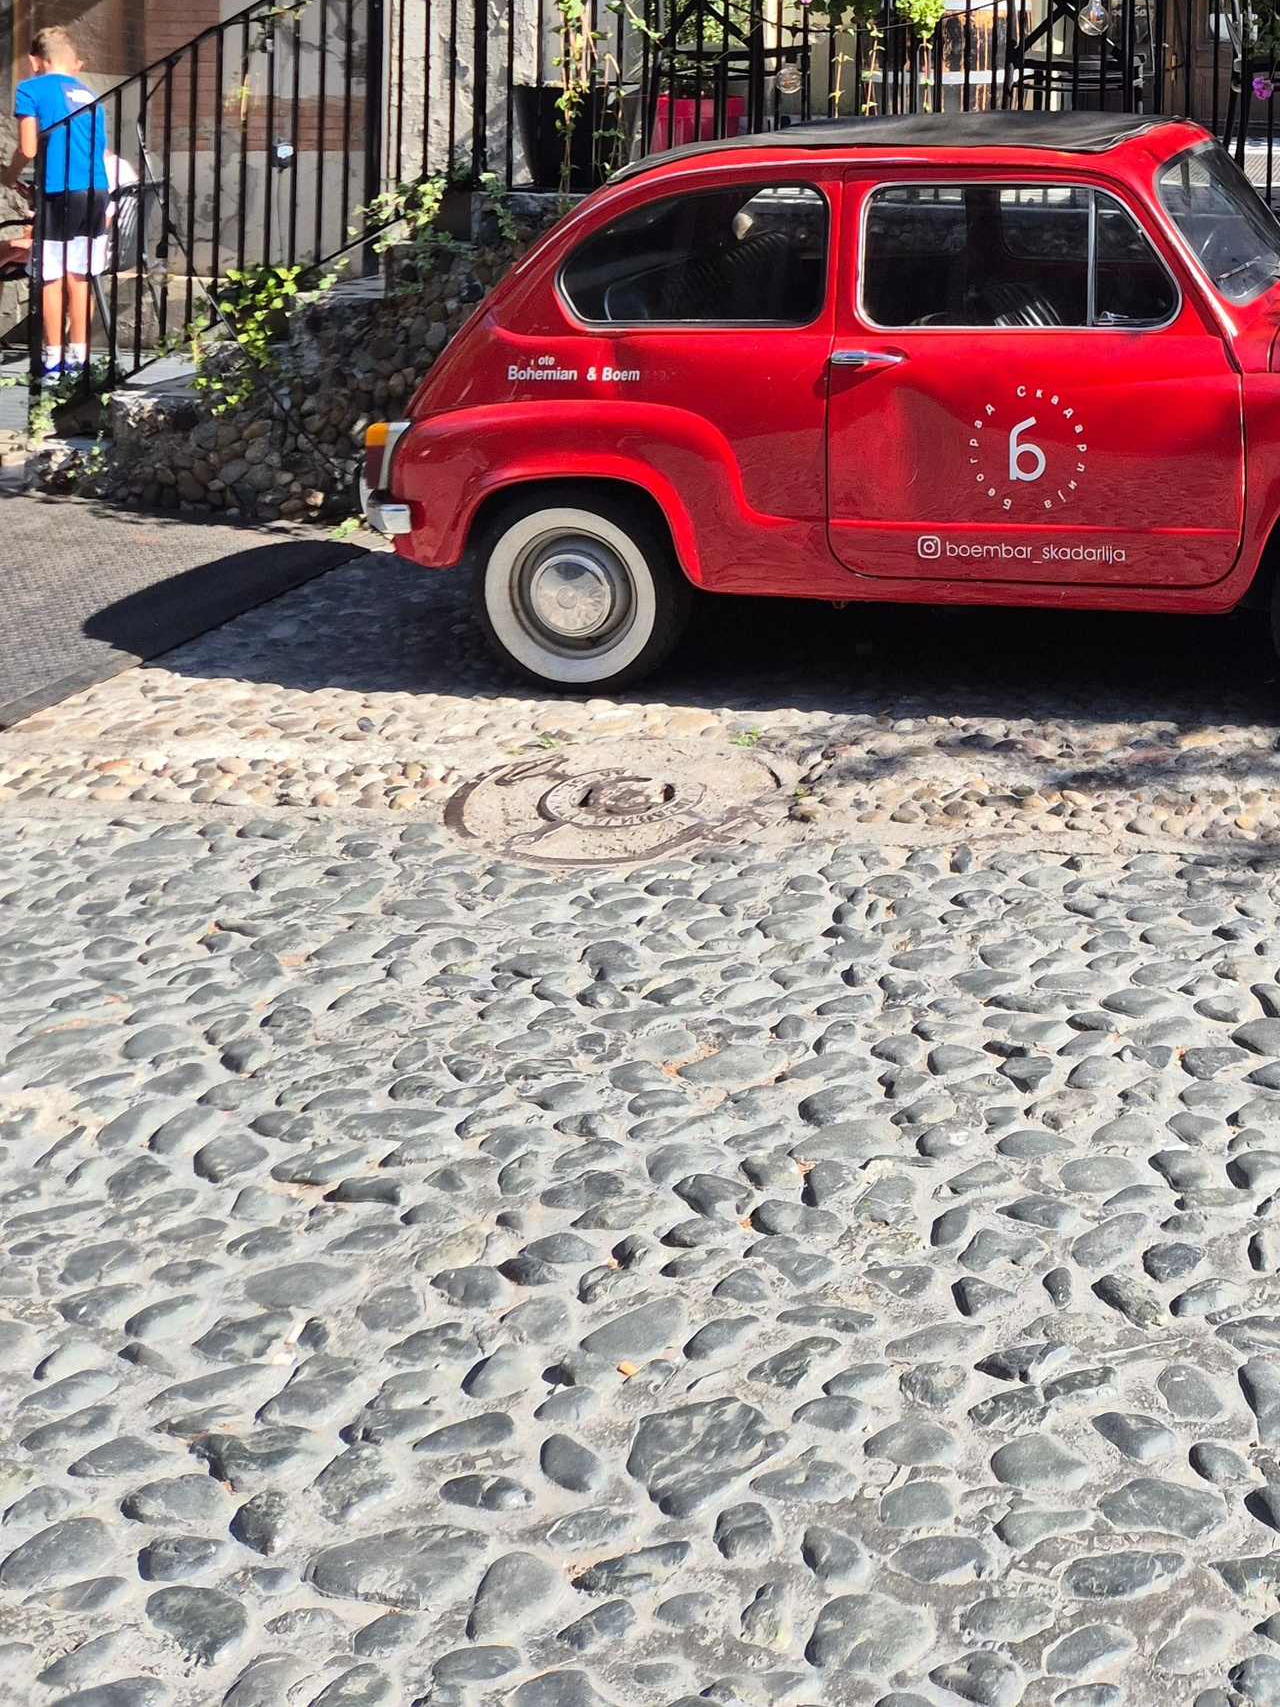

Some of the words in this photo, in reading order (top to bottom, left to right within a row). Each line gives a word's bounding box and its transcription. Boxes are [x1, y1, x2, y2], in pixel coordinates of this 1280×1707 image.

[507, 365, 578, 381] Bohemian
[586, 366, 597, 382] &
[601, 366, 641, 382] Boem
[946, 541, 1126, 565] boembar_skadarlija
